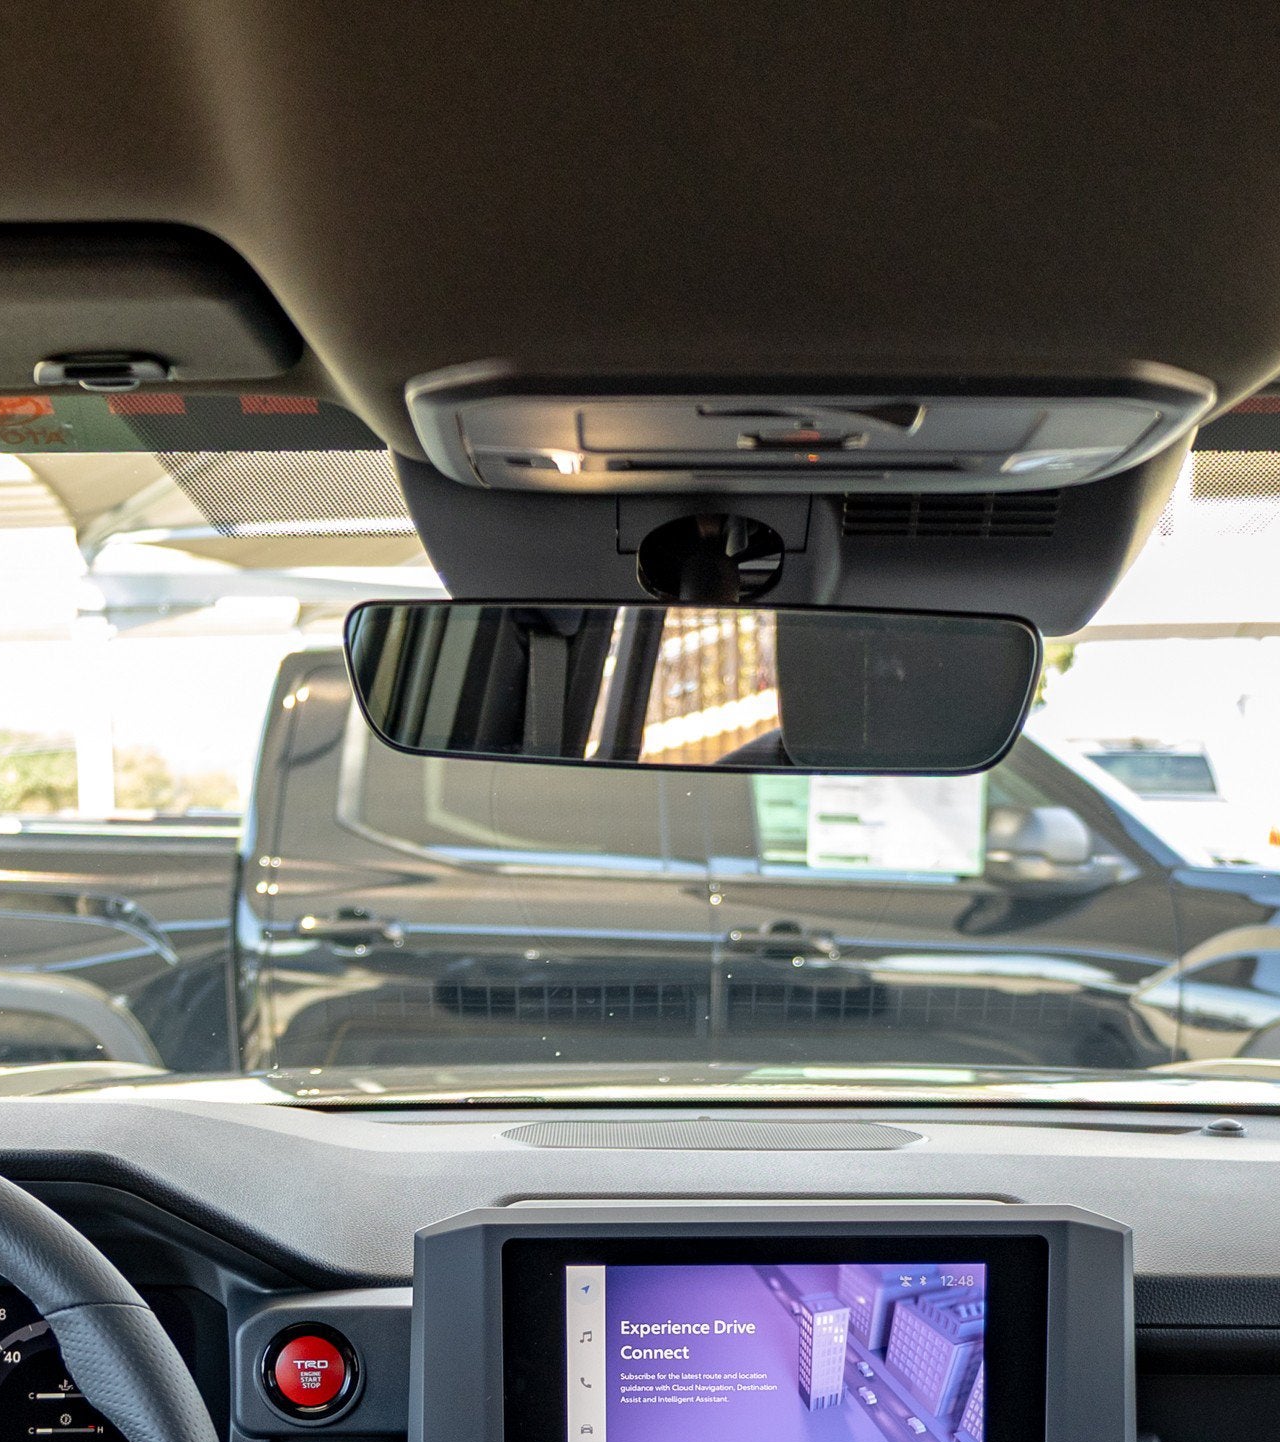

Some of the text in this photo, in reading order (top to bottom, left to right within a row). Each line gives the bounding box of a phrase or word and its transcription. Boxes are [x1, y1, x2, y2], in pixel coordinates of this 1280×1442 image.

[939, 1273, 975, 1288] 12:48
[620, 1319, 756, 1338] Experience Drive
[3, 1351, 21, 1364] 40
[620, 1345, 691, 1360] Connect
[292, 1359, 329, 1369] TRD
[620, 1372, 656, 1381] Subscribe
[681, 1372, 702, 1380] latest
[620, 1384, 654, 1393] guidance
[654, 1384, 671, 1392] with
[694, 1384, 736, 1392] Navigation,
[736, 1383, 778, 1391] Destination
[620, 1396, 642, 1404] Assist
[657, 1395, 694, 1404] Intelligent
[695, 1395, 730, 1403] Assistant.
